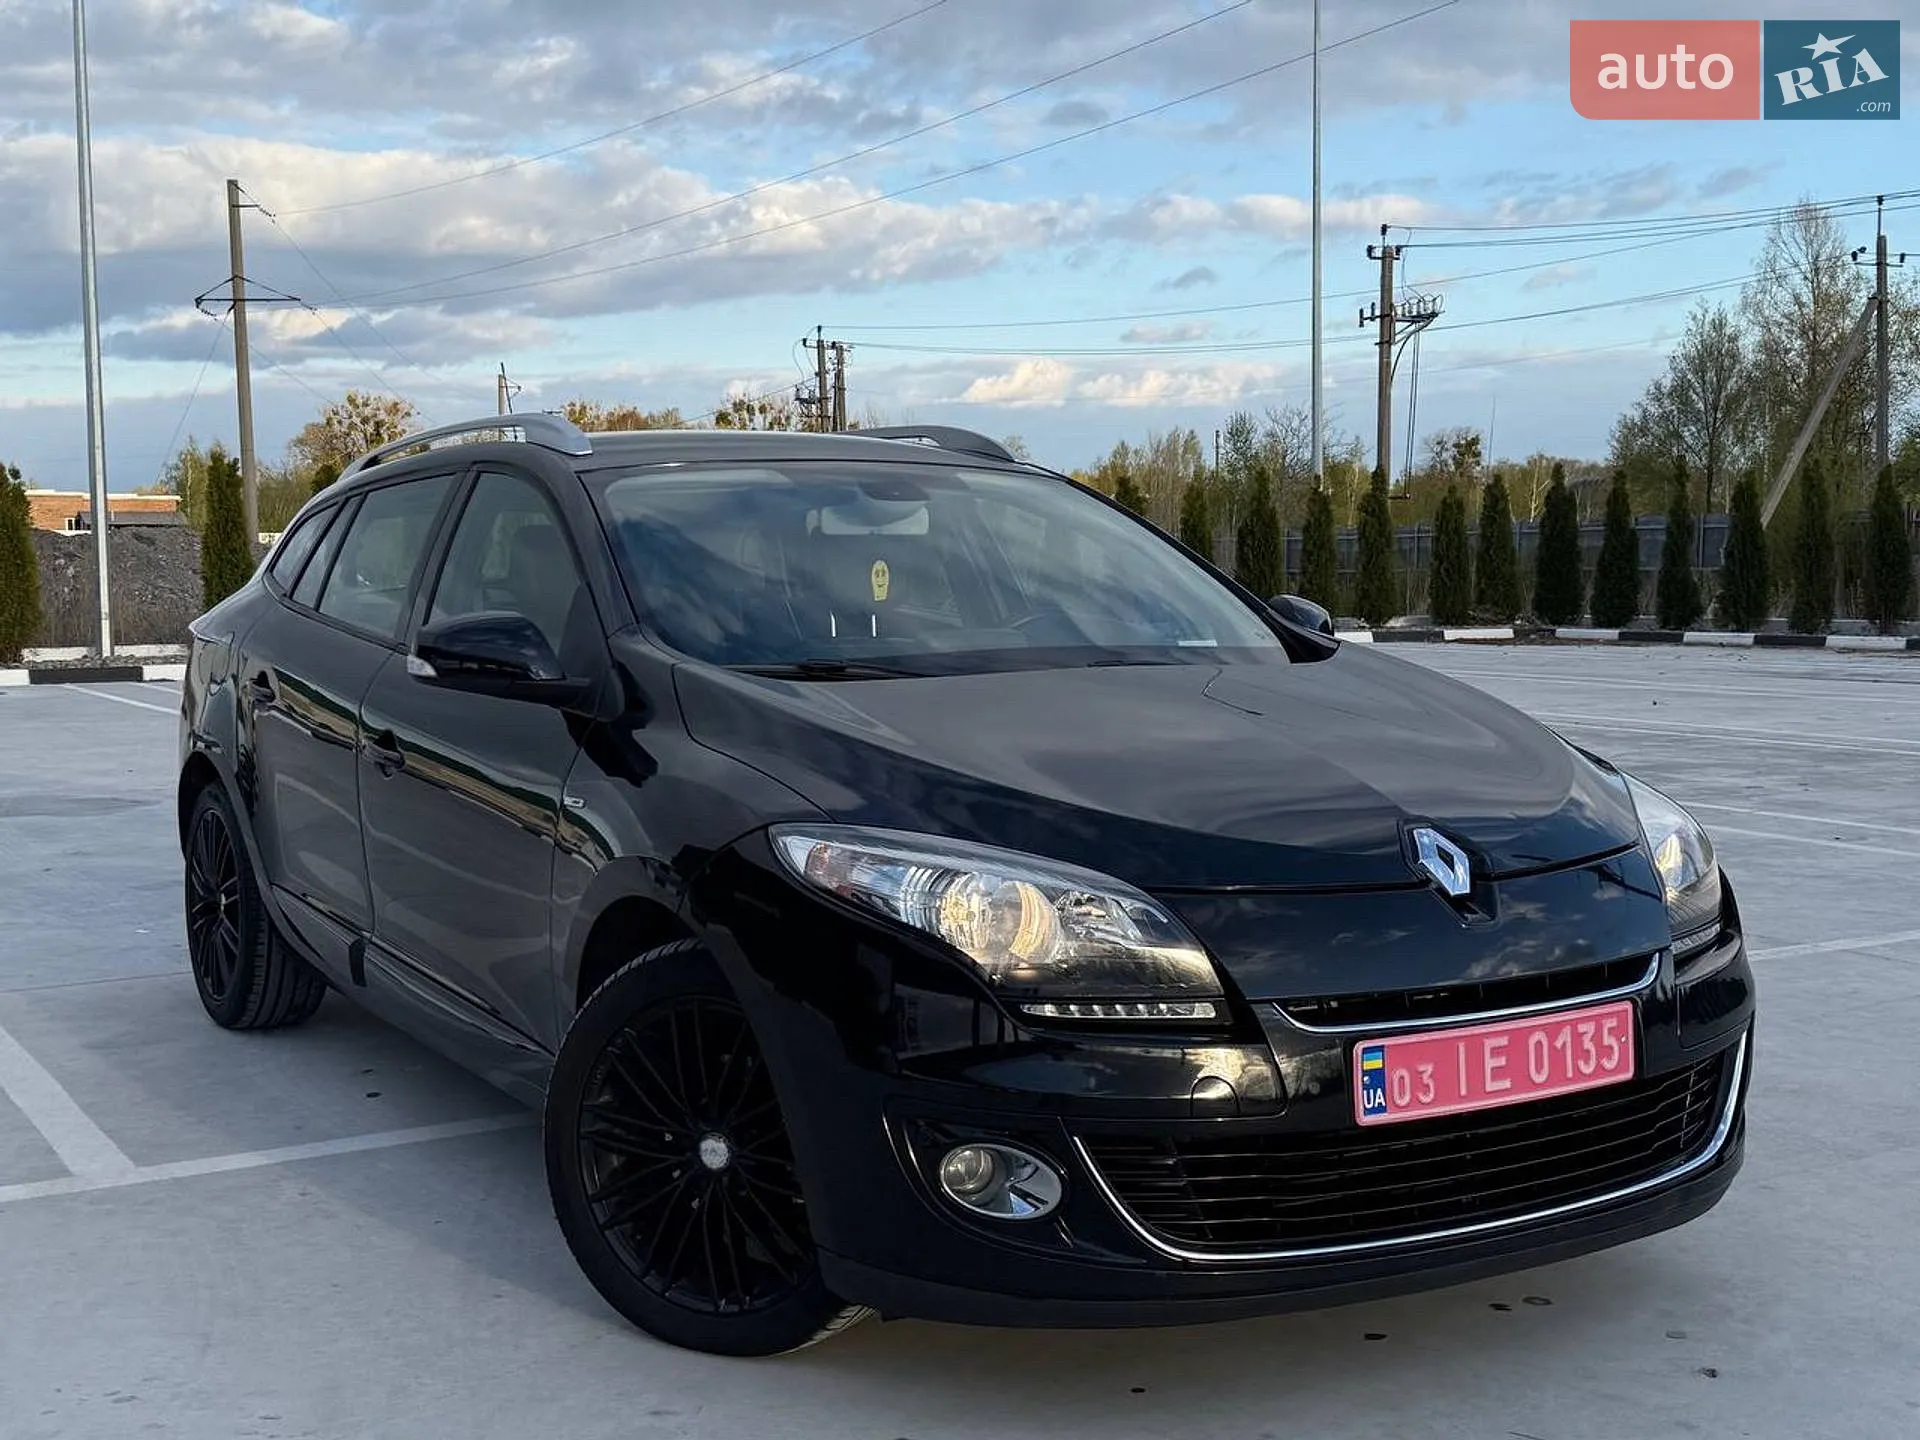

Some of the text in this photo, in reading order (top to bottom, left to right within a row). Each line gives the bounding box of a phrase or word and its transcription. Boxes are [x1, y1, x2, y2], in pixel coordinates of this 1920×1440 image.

[1391, 1062, 1435, 1107] 03
[1528, 1018, 1619, 1084] 0135
[1363, 1087, 1386, 1110] UA
